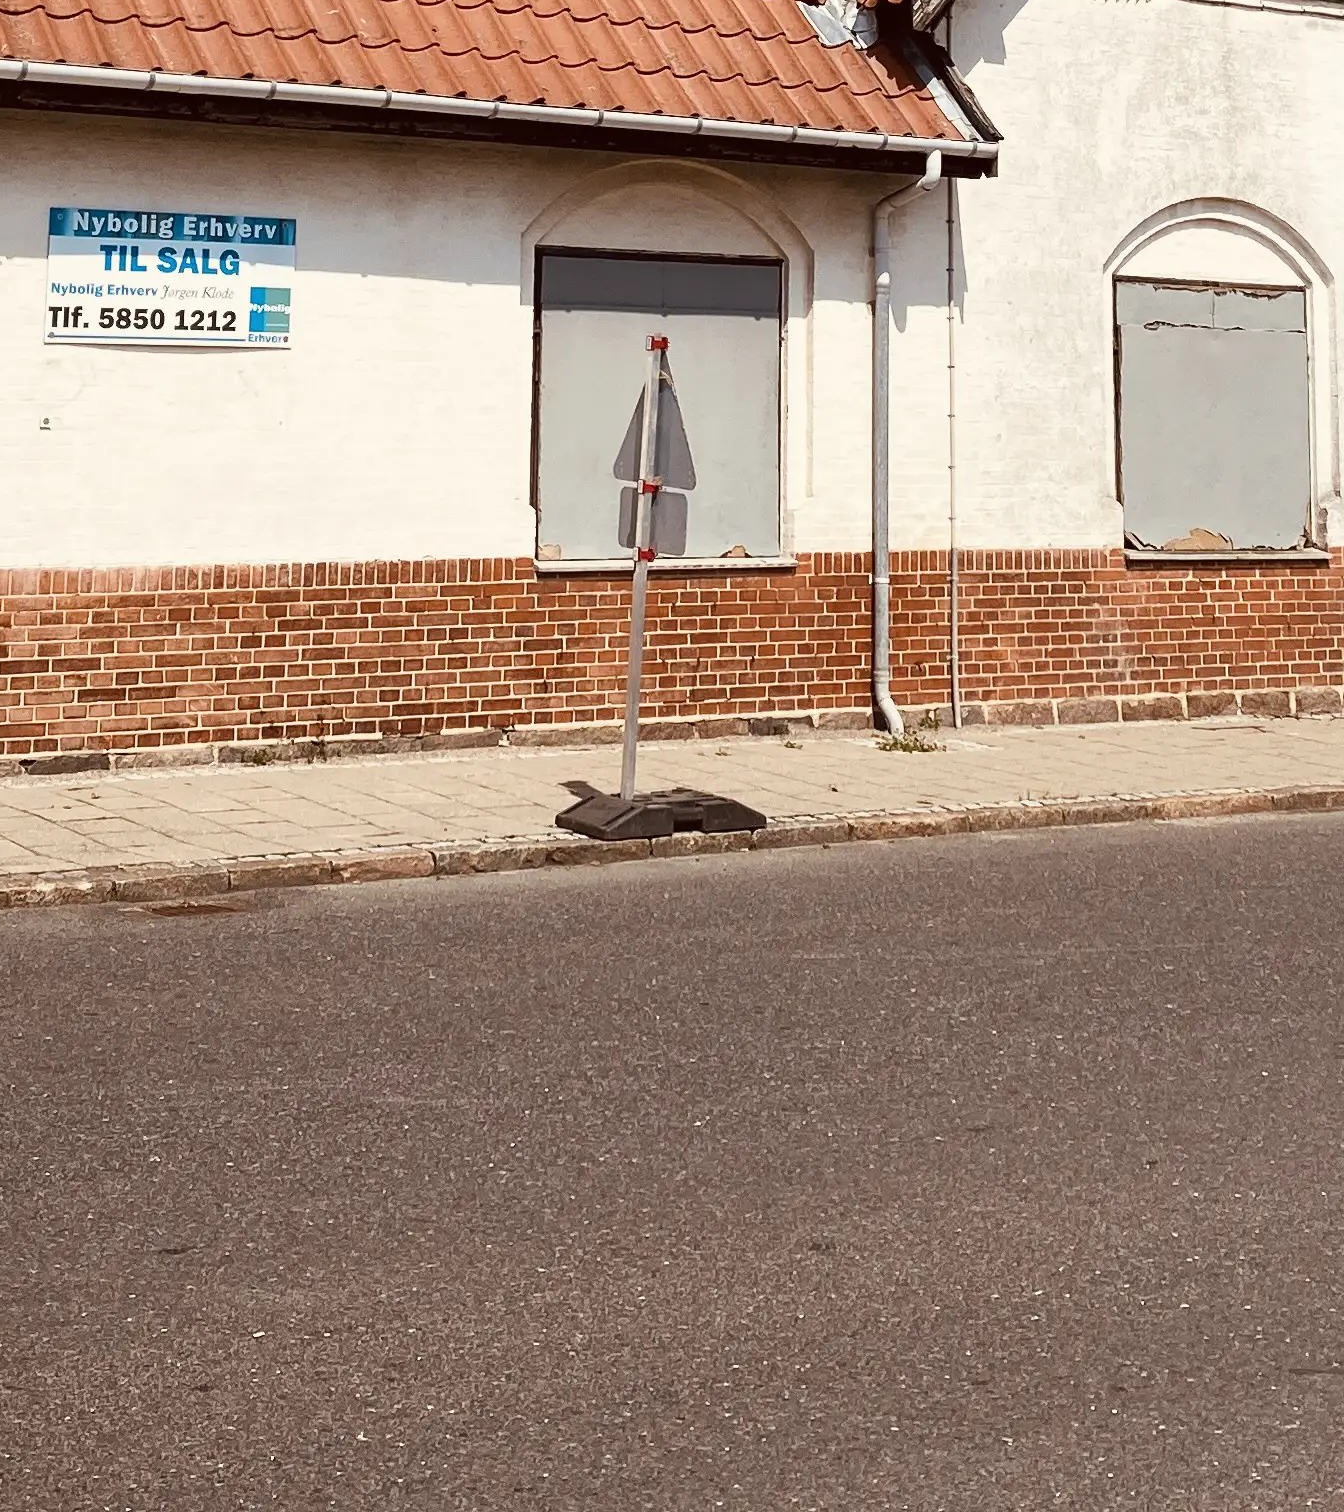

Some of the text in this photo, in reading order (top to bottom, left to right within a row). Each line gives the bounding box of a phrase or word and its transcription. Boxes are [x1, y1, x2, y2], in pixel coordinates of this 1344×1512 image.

[73, 211, 277, 239] Nybolig Erhverv
[99, 244, 240, 275] TIL SALG
[51, 282, 103, 297] Nybolig
[107, 284, 157, 296] Erhverv
[48, 306, 236, 331] Tlf. 5850 1212
[248, 334, 288, 343] Erhver
